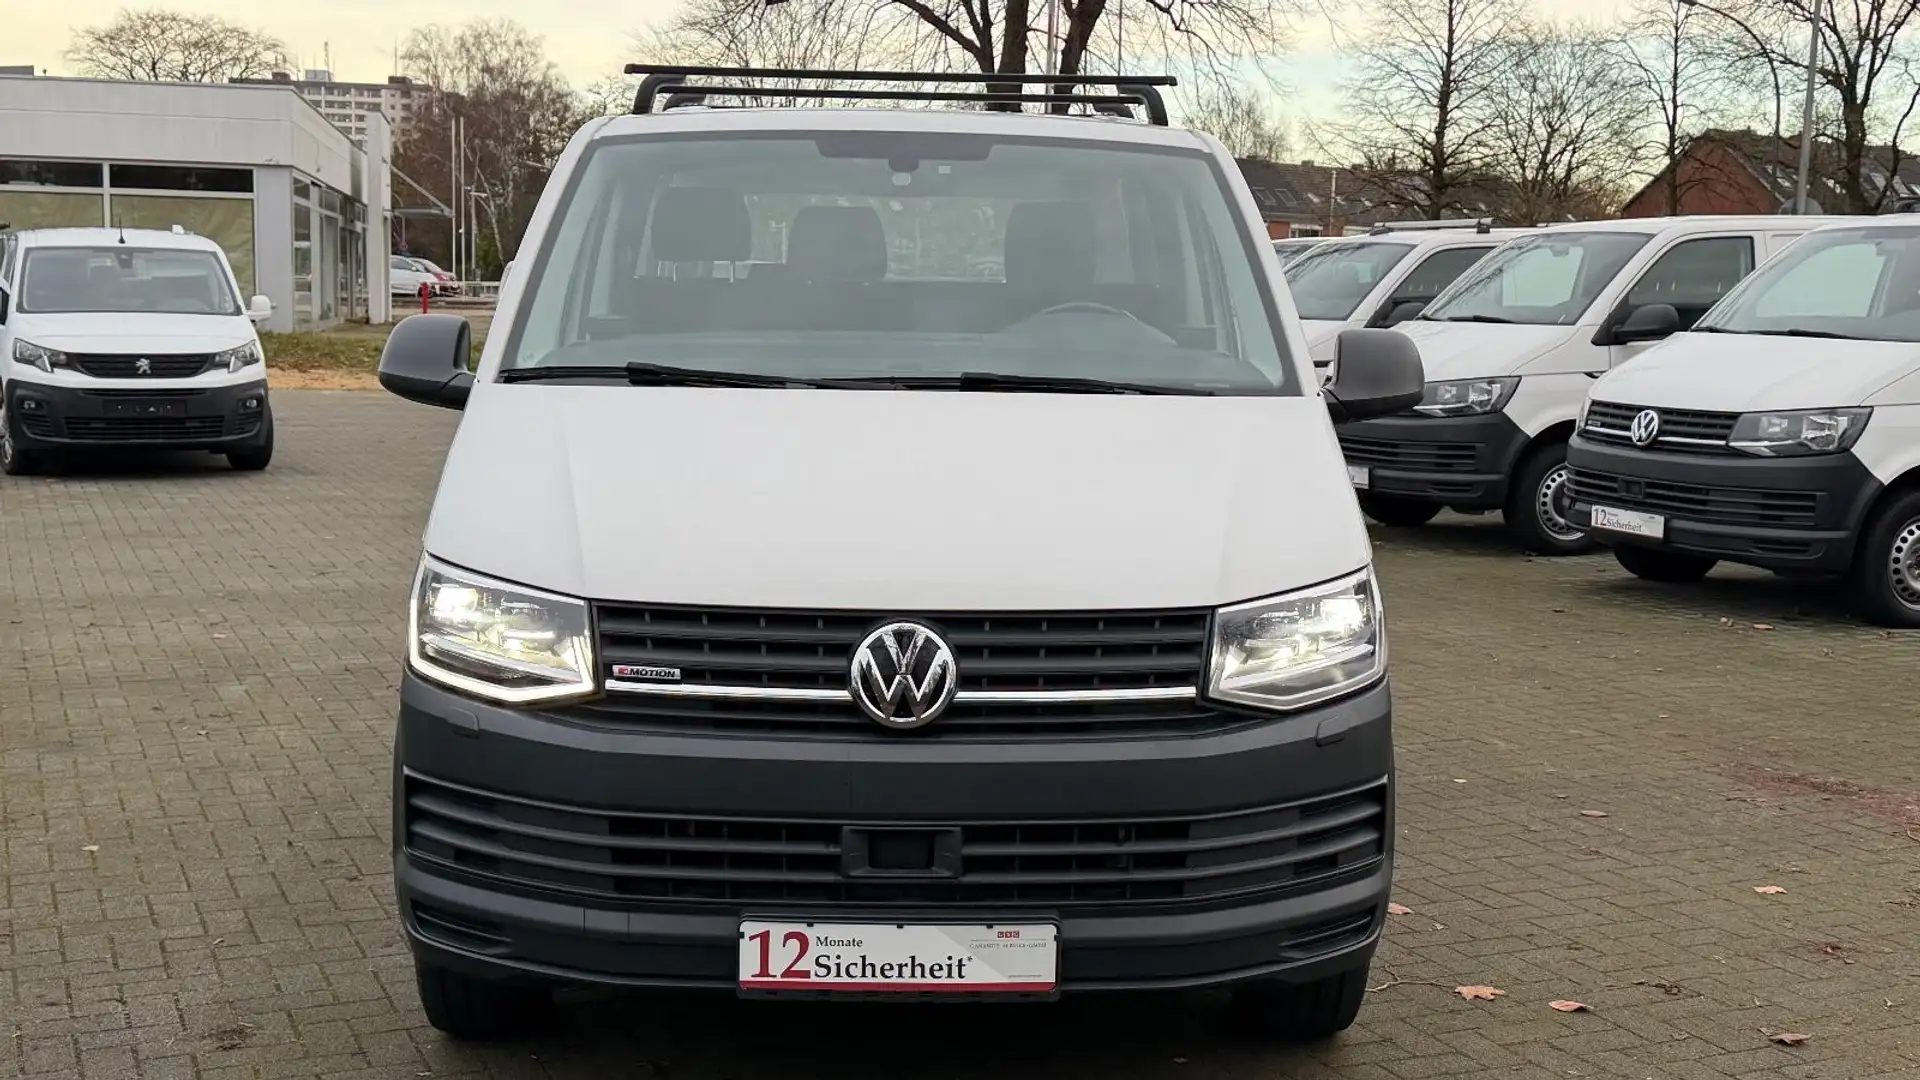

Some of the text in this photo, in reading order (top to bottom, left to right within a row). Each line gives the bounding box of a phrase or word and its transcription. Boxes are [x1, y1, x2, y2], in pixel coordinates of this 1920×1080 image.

[1593, 508, 1606, 526] 12
[851, 623, 956, 728] VW
[749, 930, 811, 979] 12
[816, 935, 863, 948] Monate
